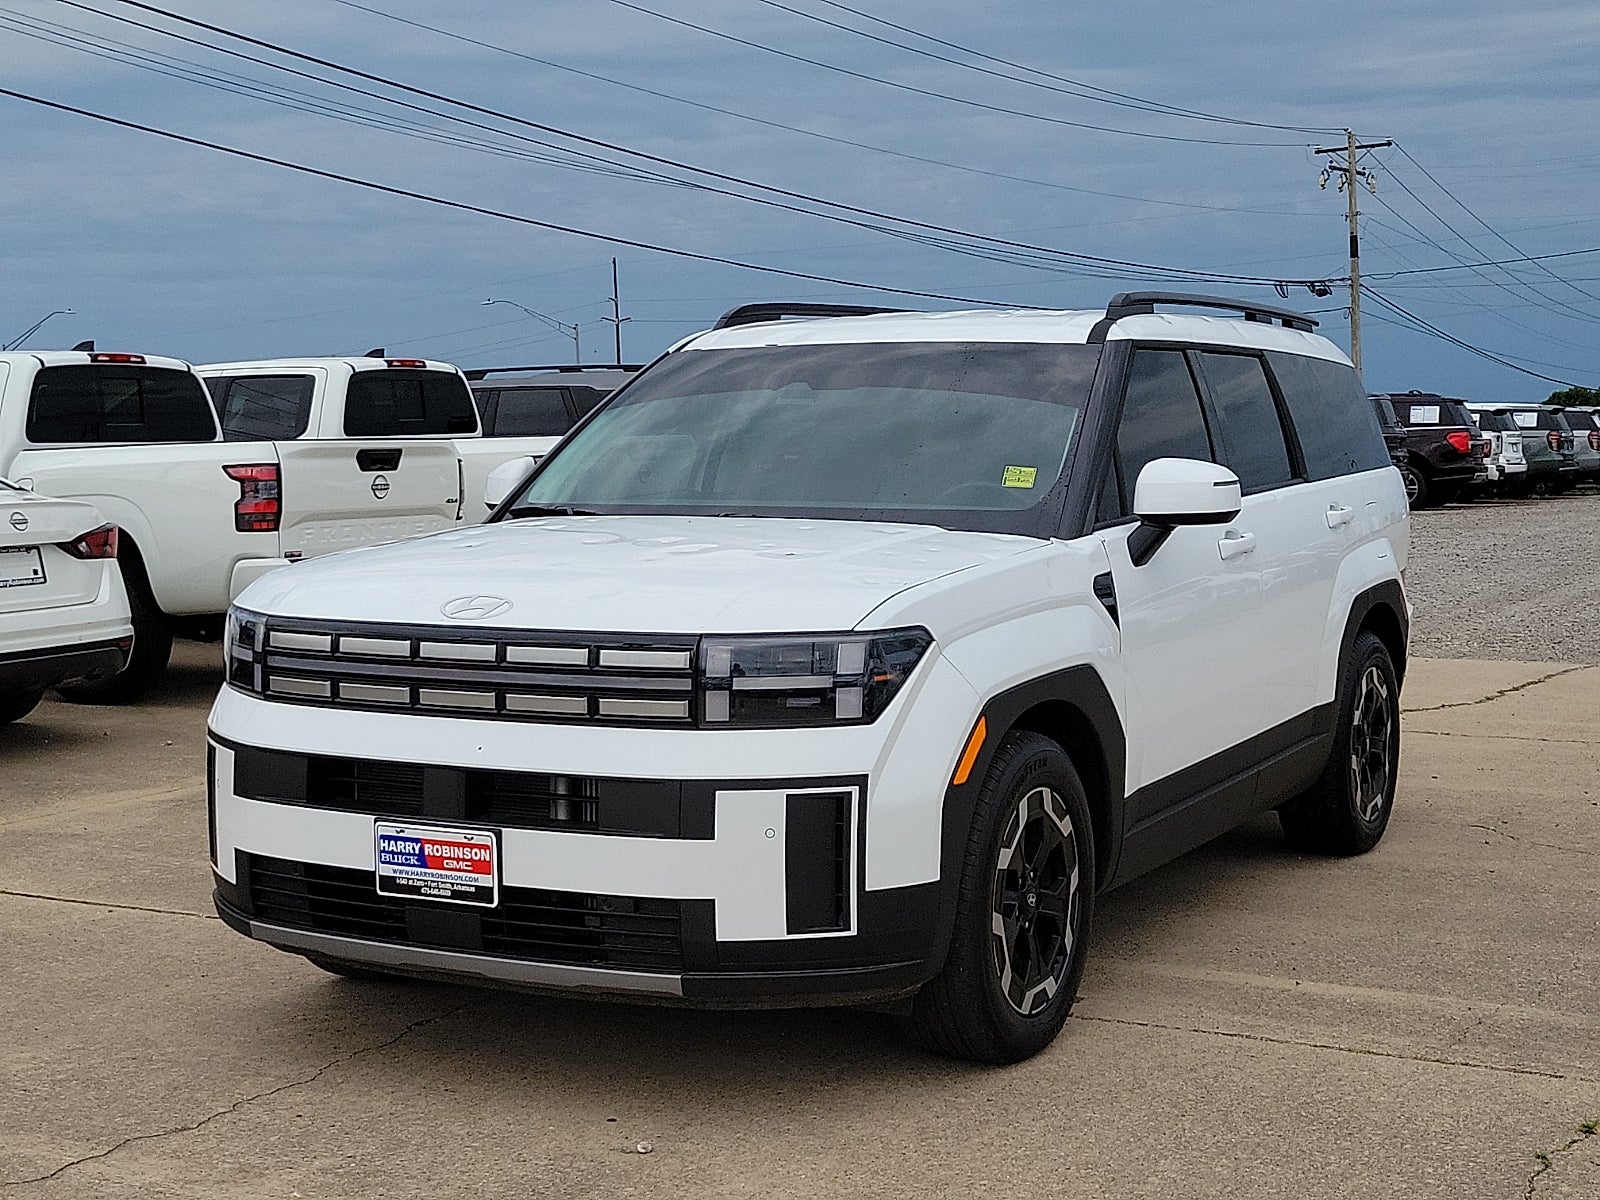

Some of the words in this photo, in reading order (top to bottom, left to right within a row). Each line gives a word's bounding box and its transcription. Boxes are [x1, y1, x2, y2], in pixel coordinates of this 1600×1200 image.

[380, 839, 421, 854] HARRY
[424, 844, 490, 861] ROBINSON
[381, 853, 418, 865] BUICK
[443, 860, 473, 870] GMC
[392, 868, 479, 883] WWW.HARRYROBINSON.COM
